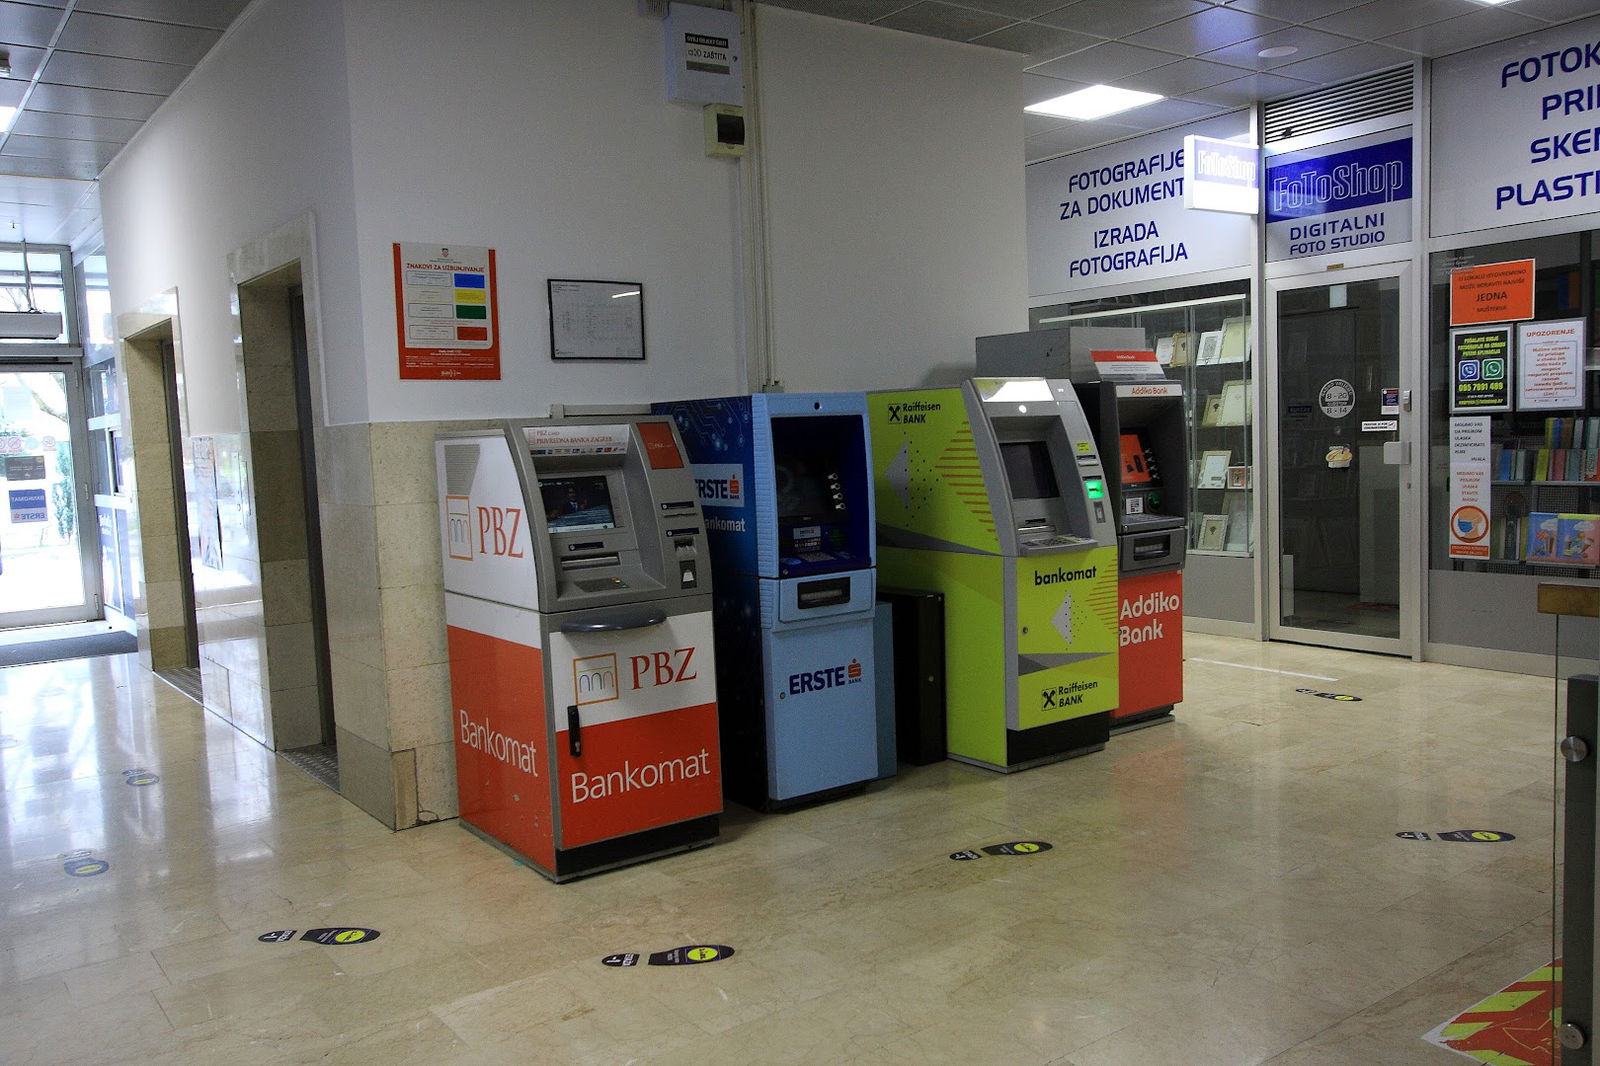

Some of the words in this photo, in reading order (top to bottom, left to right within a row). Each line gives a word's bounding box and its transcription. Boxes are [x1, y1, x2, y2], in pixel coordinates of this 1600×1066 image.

[703, 50, 727, 62] ZAŠTITA
[1501, 41, 1600, 88] FOTOK
[1542, 84, 1600, 120] PRI
[1069, 148, 1184, 193] FOTOGRAFIJE
[1273, 160, 1403, 212] FoToShop
[1060, 200, 1082, 220] ZA
[1094, 220, 1159, 249] IZRADA
[1290, 212, 1385, 241] DIGITALNI
[1290, 240, 1326, 255] FOTO
[1330, 231, 1385, 249] STUDIO
[442, 264, 485, 273] UZBUNJIVANJE
[1069, 242, 1188, 278] FOTOGRAFIJA
[1476, 291, 1508, 302] JEDNA
[1526, 328, 1576, 338] UPOZORENJE
[1131, 387, 1152, 395] Addiko
[902, 401, 941, 412] Raiffeisen
[903, 413, 926, 424] BANK
[570, 436, 590, 444] BANKA
[695, 479, 728, 499] RSTE
[476, 506, 524, 558] PBZ
[1034, 566, 1097, 586] bankomat
[1119, 591, 1180, 621] Addiko
[1119, 618, 1164, 647] Bank
[628, 647, 698, 690] PBZ
[789, 666, 846, 695] ERSTE
[1058, 680, 1098, 696] Raiffeisen
[1059, 694, 1084, 708] BANK
[459, 709, 539, 777] Bankomat
[570, 748, 711, 803] Bankomat
